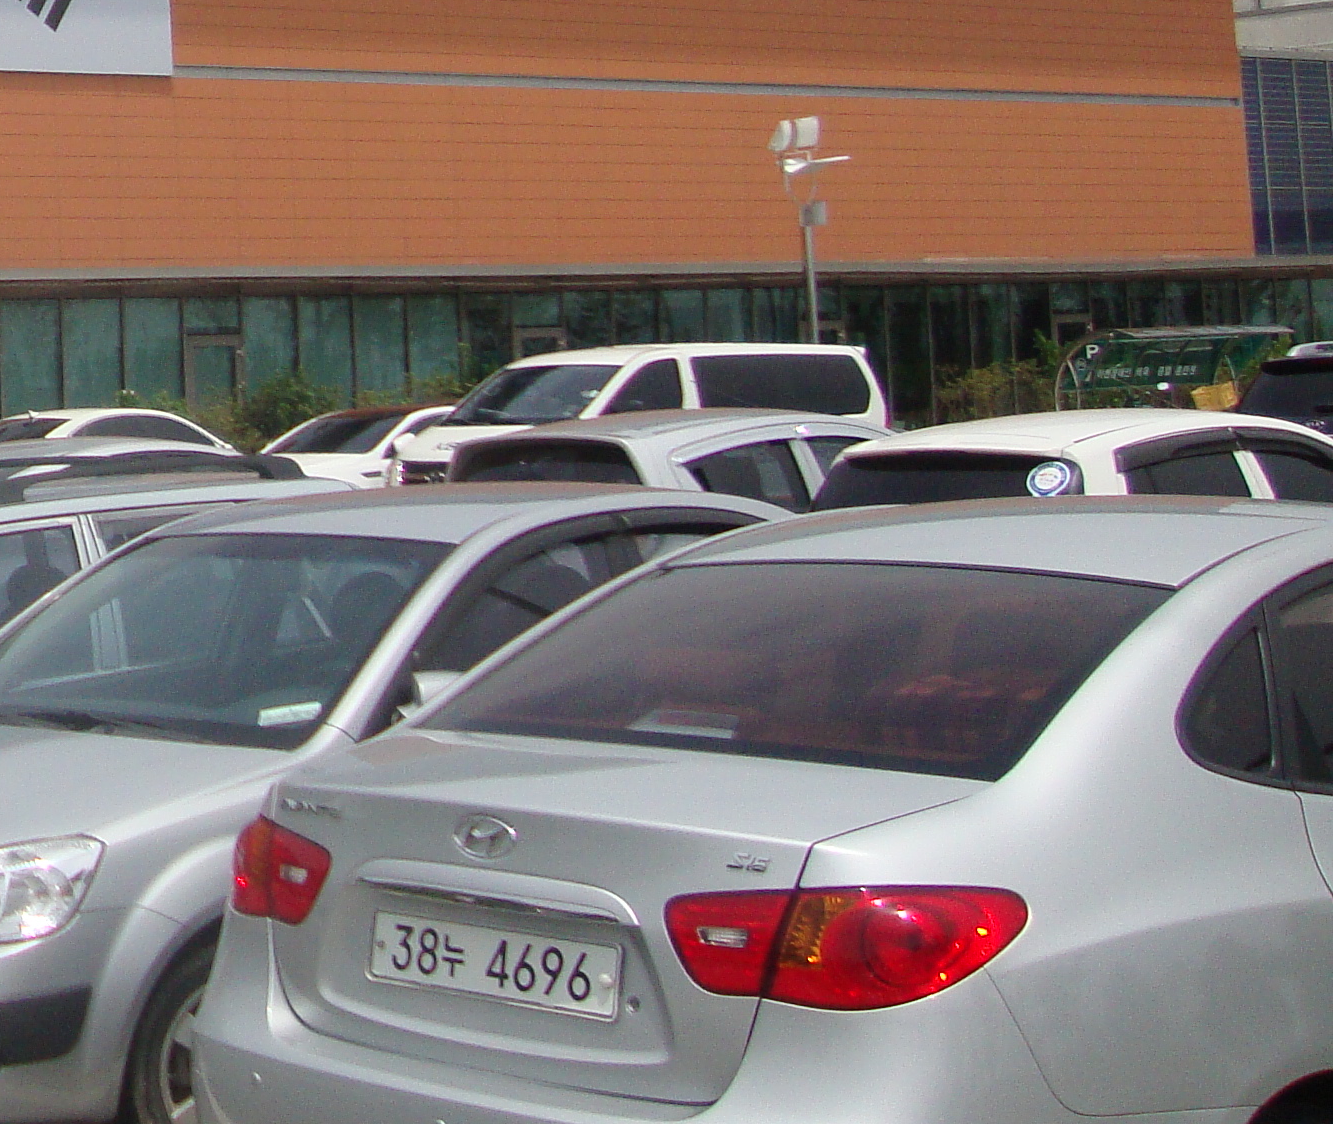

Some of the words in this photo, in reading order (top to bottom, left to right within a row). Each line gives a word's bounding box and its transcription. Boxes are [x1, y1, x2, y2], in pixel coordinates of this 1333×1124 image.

[1085, 344, 1100, 359] P
[391, 923, 465, 978] 38누
[485, 938, 592, 1002] 4696
